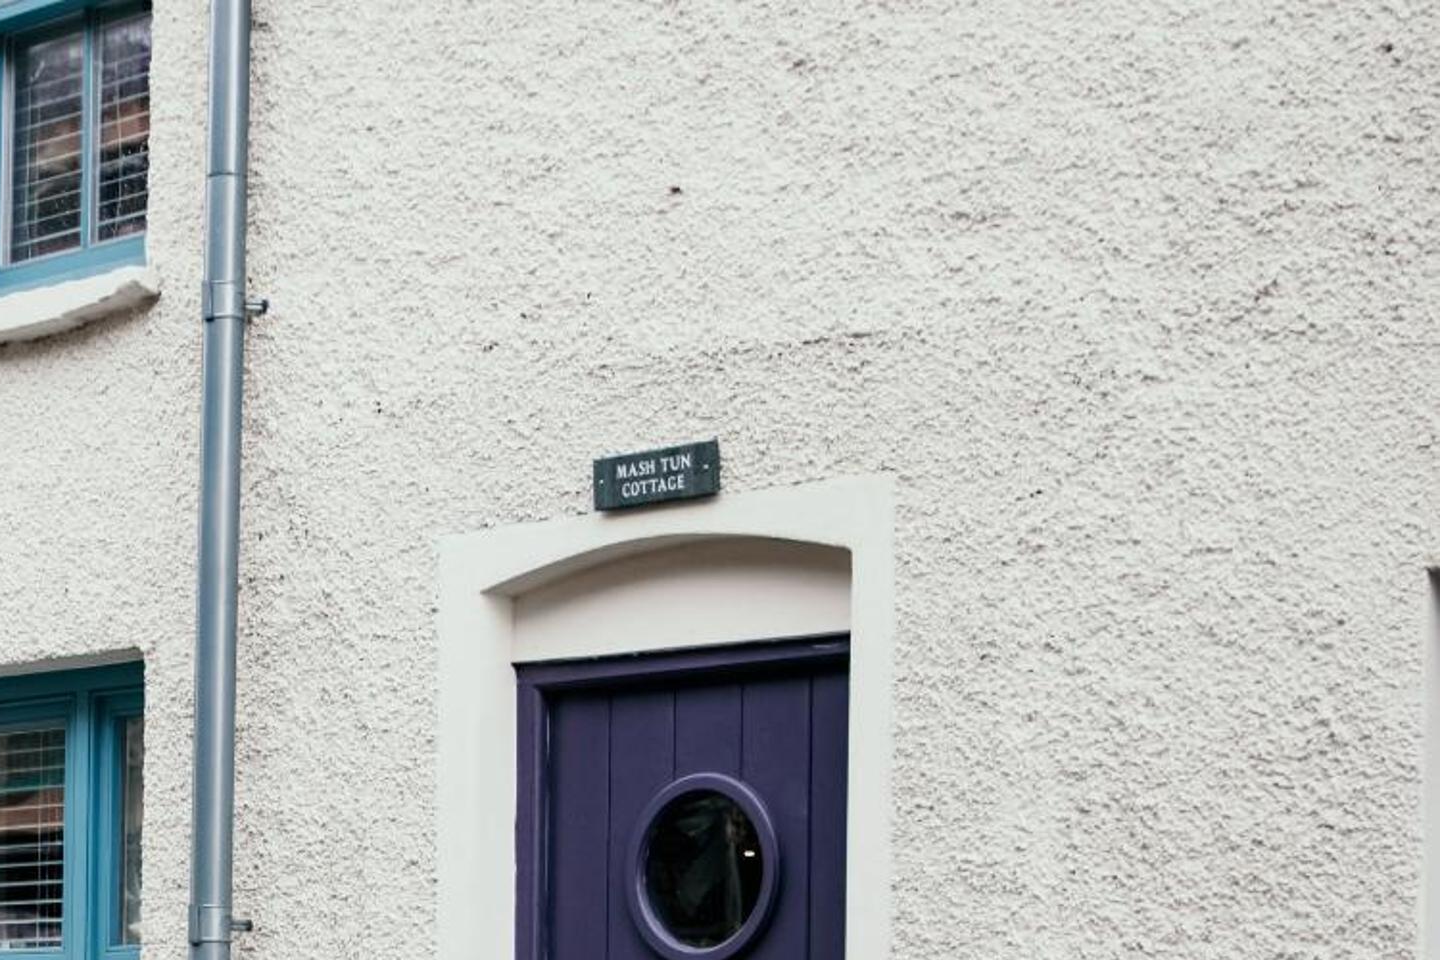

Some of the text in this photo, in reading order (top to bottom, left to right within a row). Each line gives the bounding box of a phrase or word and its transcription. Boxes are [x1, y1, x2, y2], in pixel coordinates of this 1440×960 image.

[616, 453, 691, 479] MASH TUN
[622, 474, 685, 498] COTTAGE
